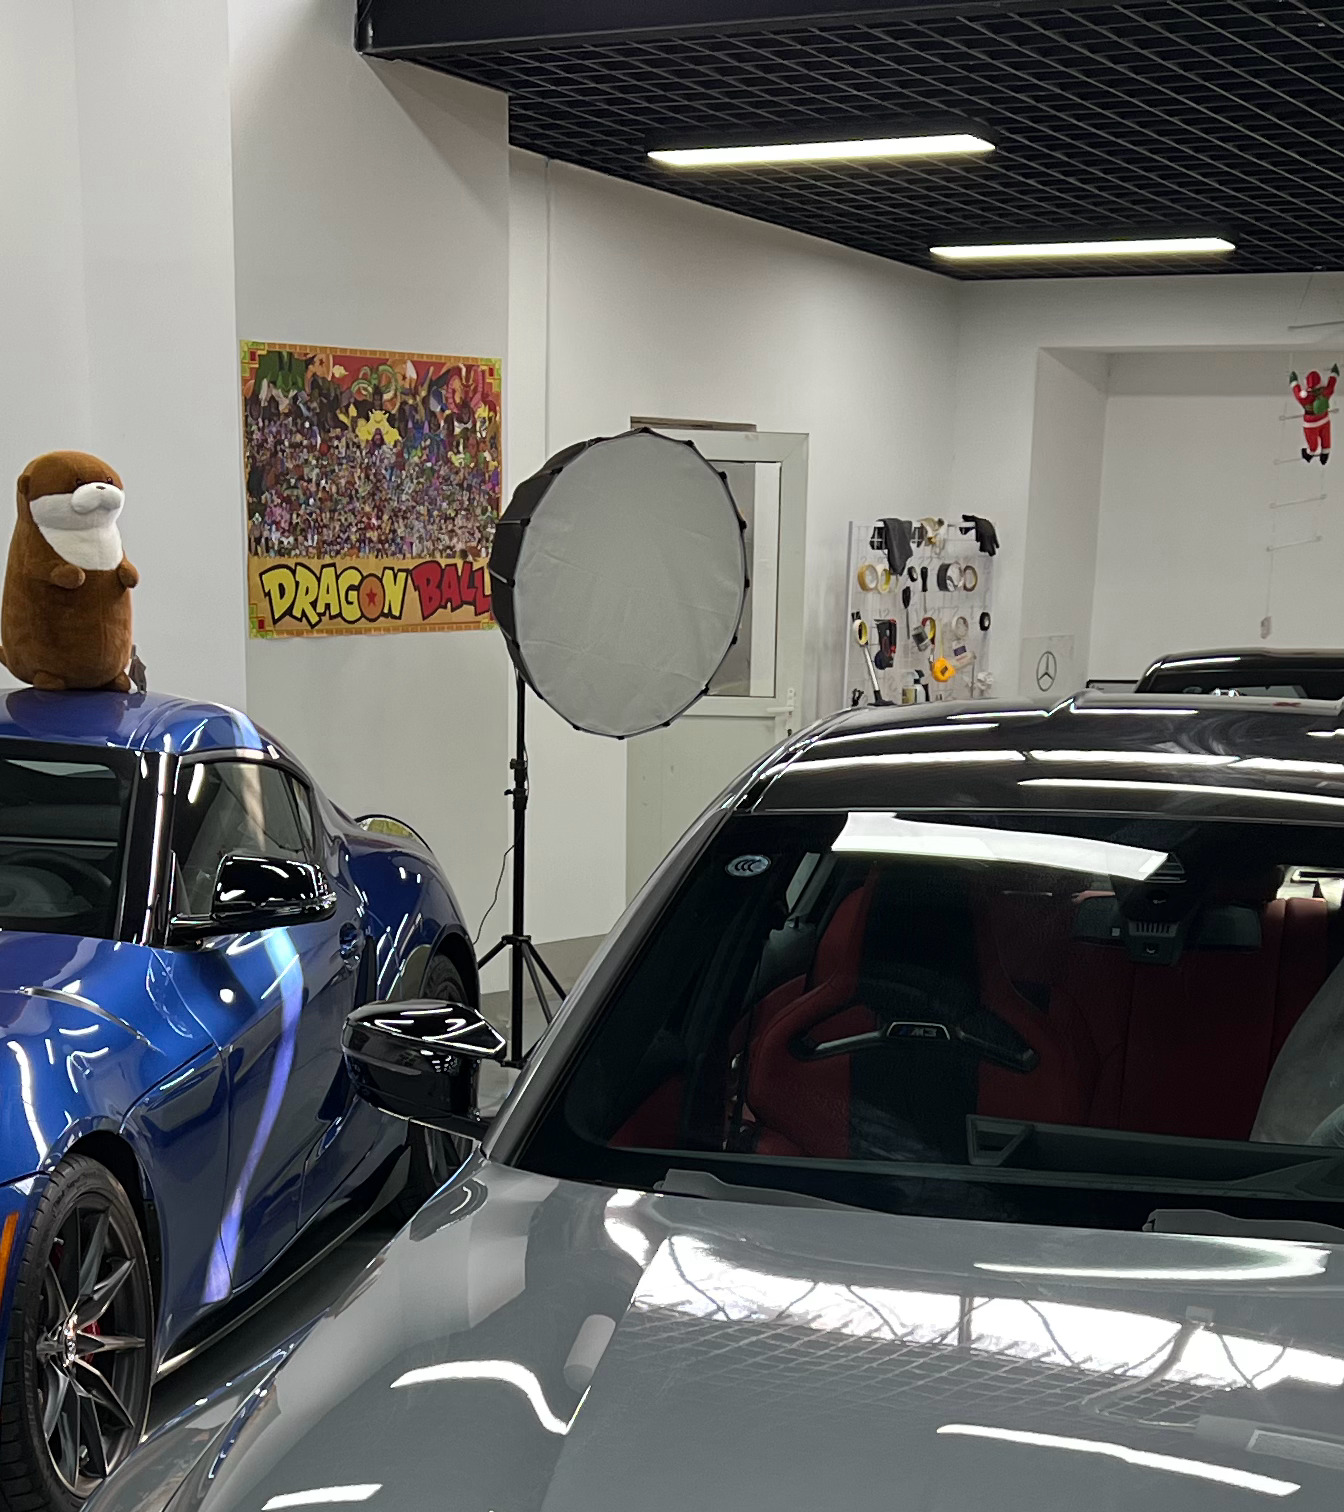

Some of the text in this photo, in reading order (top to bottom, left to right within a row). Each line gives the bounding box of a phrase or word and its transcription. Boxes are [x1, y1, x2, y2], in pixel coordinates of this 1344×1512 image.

[259, 560, 493, 629] DRAGON BALL
[911, 1027, 938, 1038] M3
